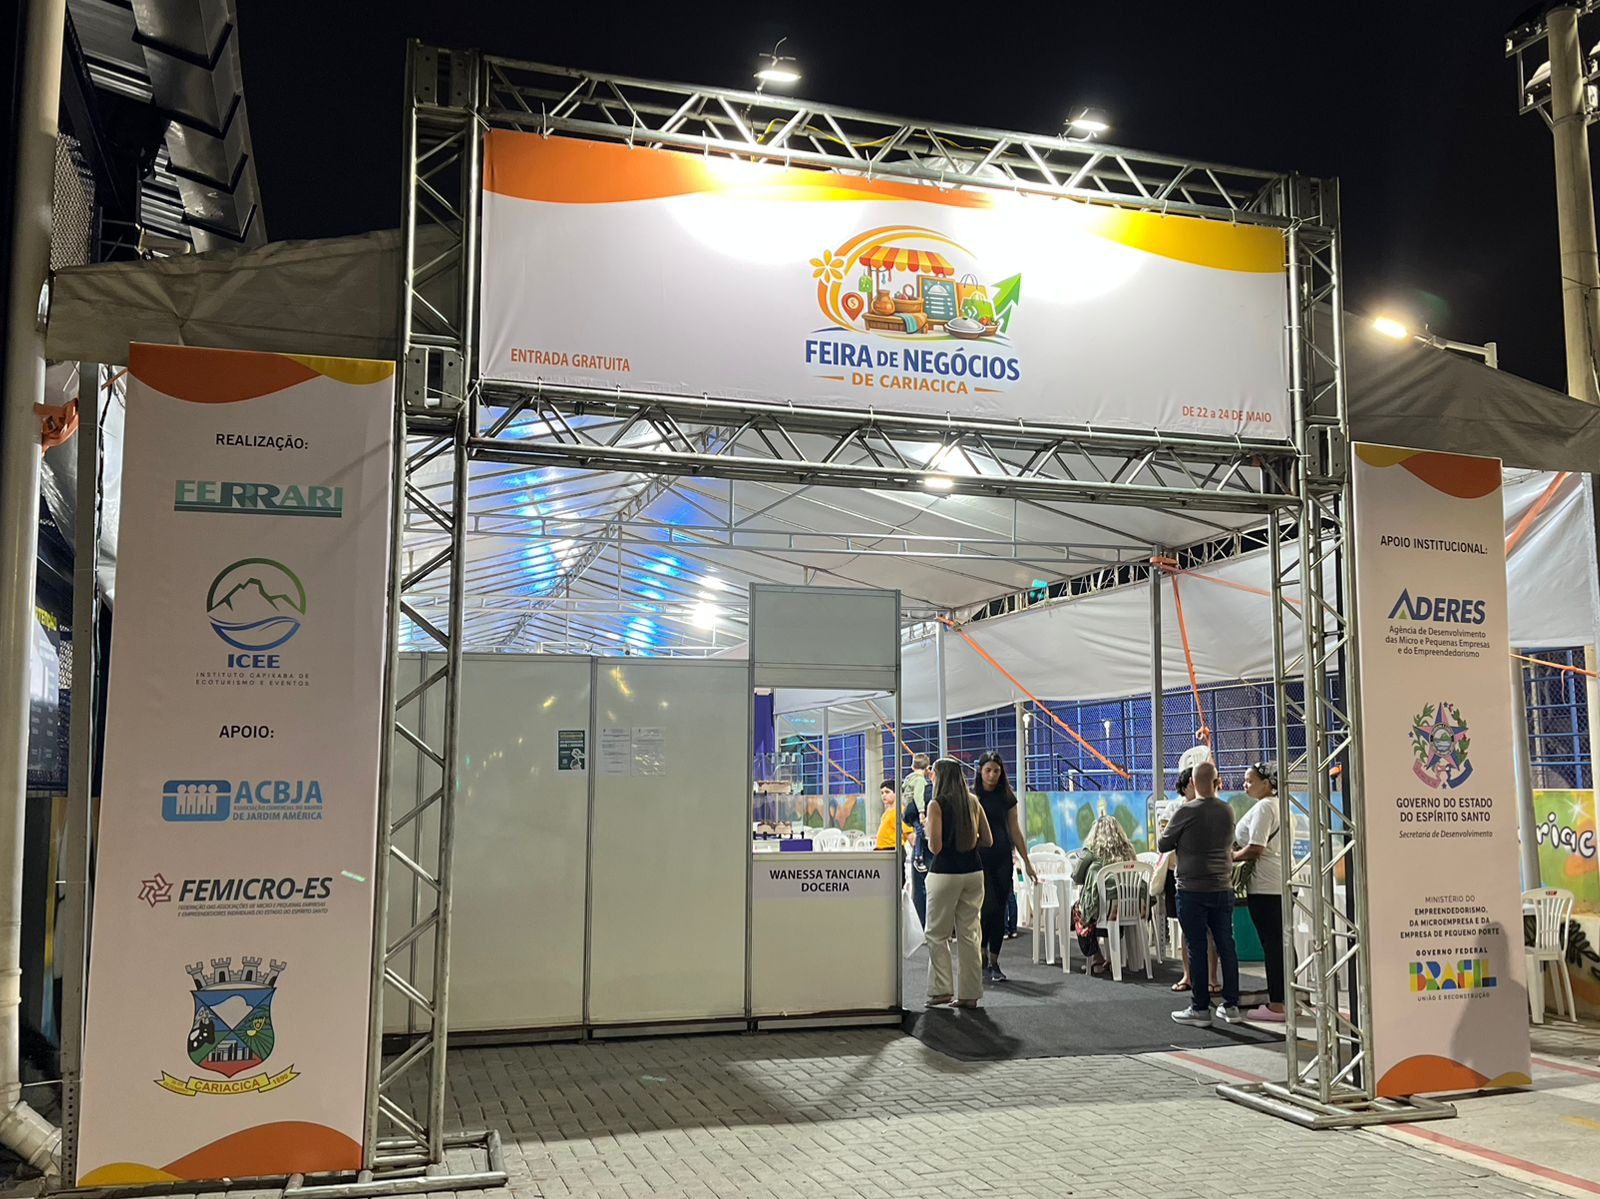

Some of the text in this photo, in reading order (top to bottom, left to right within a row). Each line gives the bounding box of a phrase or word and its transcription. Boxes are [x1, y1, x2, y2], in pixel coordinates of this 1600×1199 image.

[510, 347, 630, 372] ENTRADA GRATUITA
[805, 339, 1020, 381] FEIRA DE NEGÓCIOS
[852, 371, 968, 394] DE CARIACICA
[1182, 406, 1194, 417] DE
[1197, 407, 1208, 418] 22
[1218, 408, 1229, 419] 24
[1231, 410, 1243, 421] DE
[1246, 411, 1272, 423] MAIO
[216, 433, 309, 451] REALIZAÇÃO:
[174, 479, 343, 509] FERRARI
[1380, 535, 1488, 555] APOIO INSTITUCIONAL:
[1387, 587, 1486, 625] ADERES
[1389, 625, 1486, 639] Agência de Desenvolvimento
[1385, 635, 1397, 645] das
[1398, 636, 1419, 646] Micro
[1425, 637, 1458, 649] Pequenas
[1459, 639, 1490, 650] Empresas
[1403, 646, 1413, 655] do
[1413, 647, 1480, 659] Empreendedorismo
[227, 653, 281, 669] ICEE
[219, 723, 275, 740] APOIO:
[233, 780, 323, 804] ACBJA
[1396, 797, 1493, 809] GOVERNO DO ESTADO
[233, 810, 322, 821] DE JARDIM AMÉRICA
[1400, 809, 1491, 823] DO ESPÍRITO SANTO
[1399, 829, 1493, 839] Secretaria de Desenvolvimento
[1536, 811, 1596, 858] riac
[769, 869, 881, 880] WANESSA TANCIANA
[178, 877, 333, 902] FEMICRO-ES
[801, 882, 850, 892] DOCERIA
[1425, 895, 1475, 903] MINISTÉRIO DO
[1409, 919, 1419, 927] DA
[1420, 918, 1474, 926] MICROEMPRESA
[1400, 928, 1500, 939] EMPRESA DE PEQUENO PORTE
[1415, 947, 1488, 957] GOVERNO FEDERAL
[1409, 959, 1497, 993] BRASIL
[1417, 994, 1436, 1002] UNIÃO
[1443, 992, 1490, 1001] RECONSTRUÇÃO
[194, 1079, 261, 1093] CARIACICA
